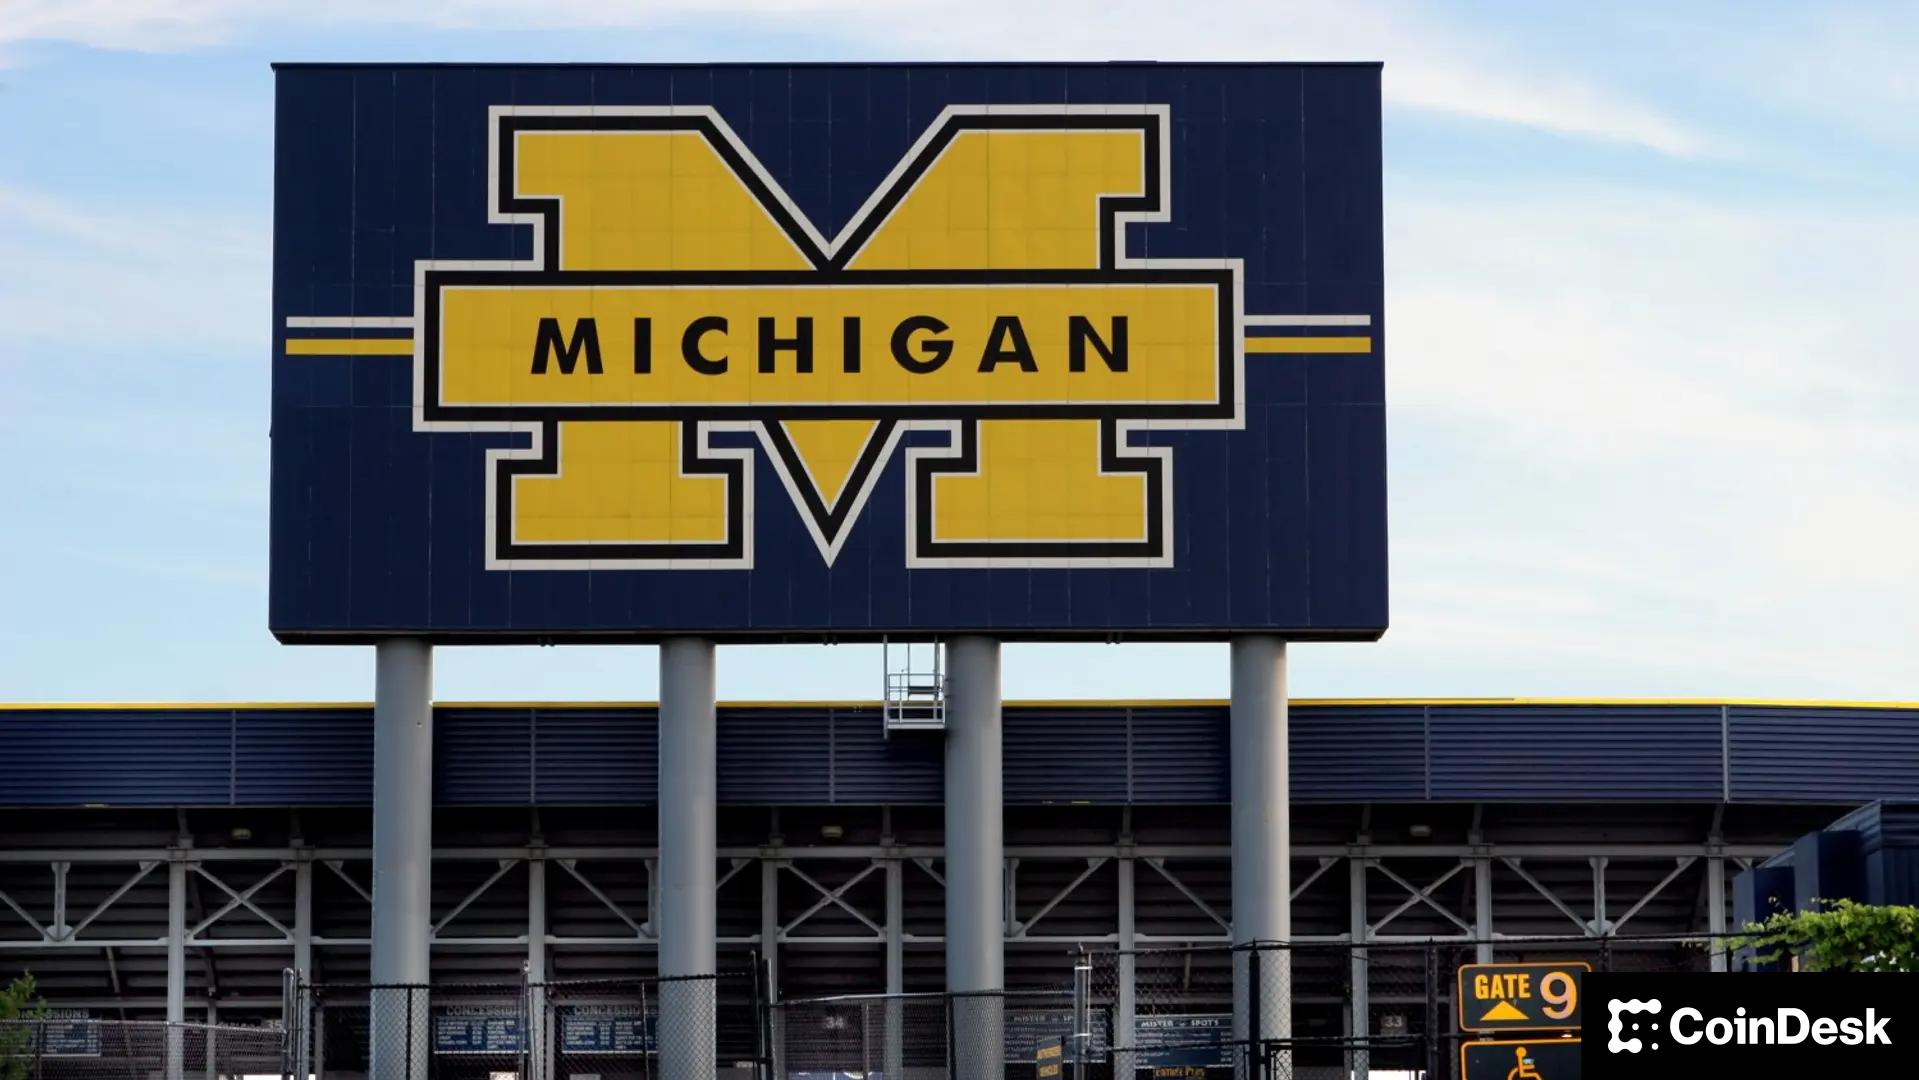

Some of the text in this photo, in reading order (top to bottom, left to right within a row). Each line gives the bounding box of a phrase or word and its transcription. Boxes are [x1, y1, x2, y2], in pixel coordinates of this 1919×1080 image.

[531, 315, 1129, 374] MICHIGAN
[1475, 971, 1577, 1020] GATE 9
[1384, 1015, 1403, 1027] 33
